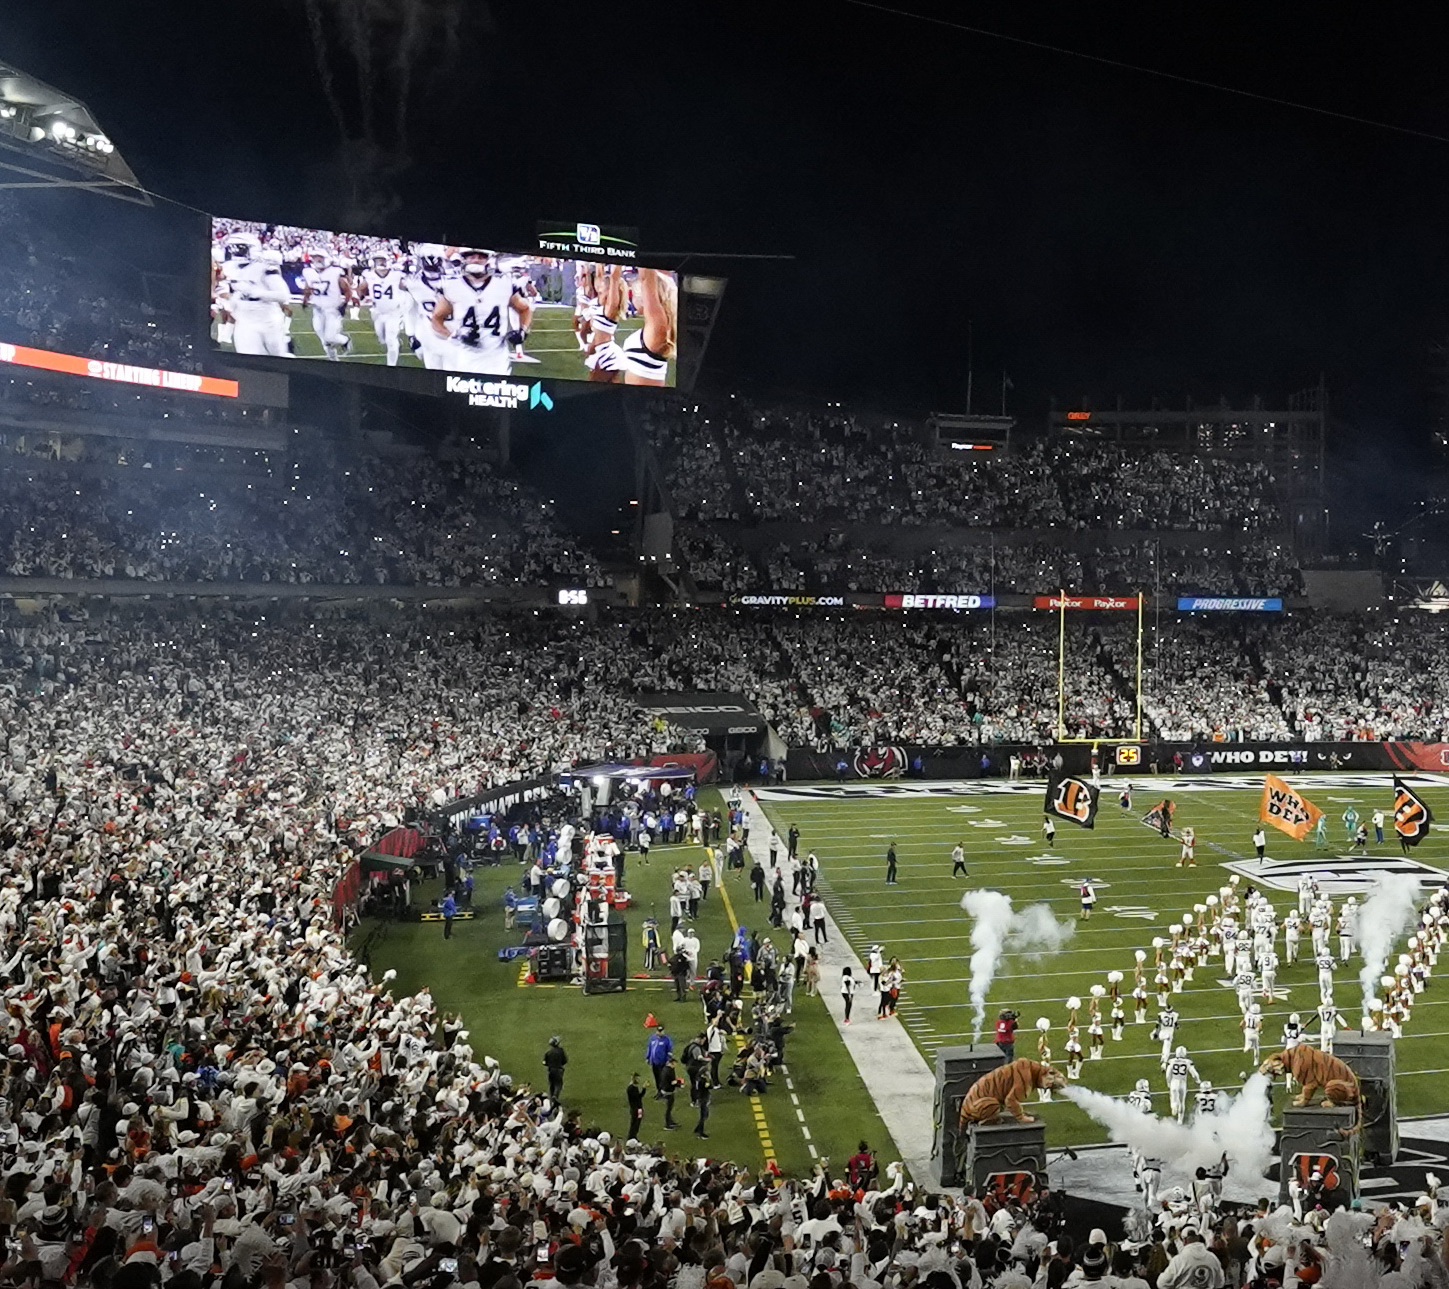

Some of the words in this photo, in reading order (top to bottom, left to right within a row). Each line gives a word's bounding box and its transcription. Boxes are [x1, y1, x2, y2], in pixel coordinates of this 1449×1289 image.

[539, 240, 570, 253] FIFTH
[572, 243, 605, 256] THIRD
[607, 247, 637, 258] BANK
[373, 283, 392, 299] 64
[461, 305, 501, 336] 44
[469, 393, 519, 409] HEALTH
[741, 595, 843, 606] GRAVITYPLUS.COM
[902, 594, 981, 608] BETFRED
[1094, 597, 1127, 609] Paycor
[1192, 598, 1267, 610] PROGRESSIVE
[1120, 748, 1137, 762] 25
[1208, 751, 1254, 763] WHO
[1259, 750, 1308, 763] DEY!
[1267, 802, 1304, 824] DEY
[1200, 1098, 1215, 1112] 23
